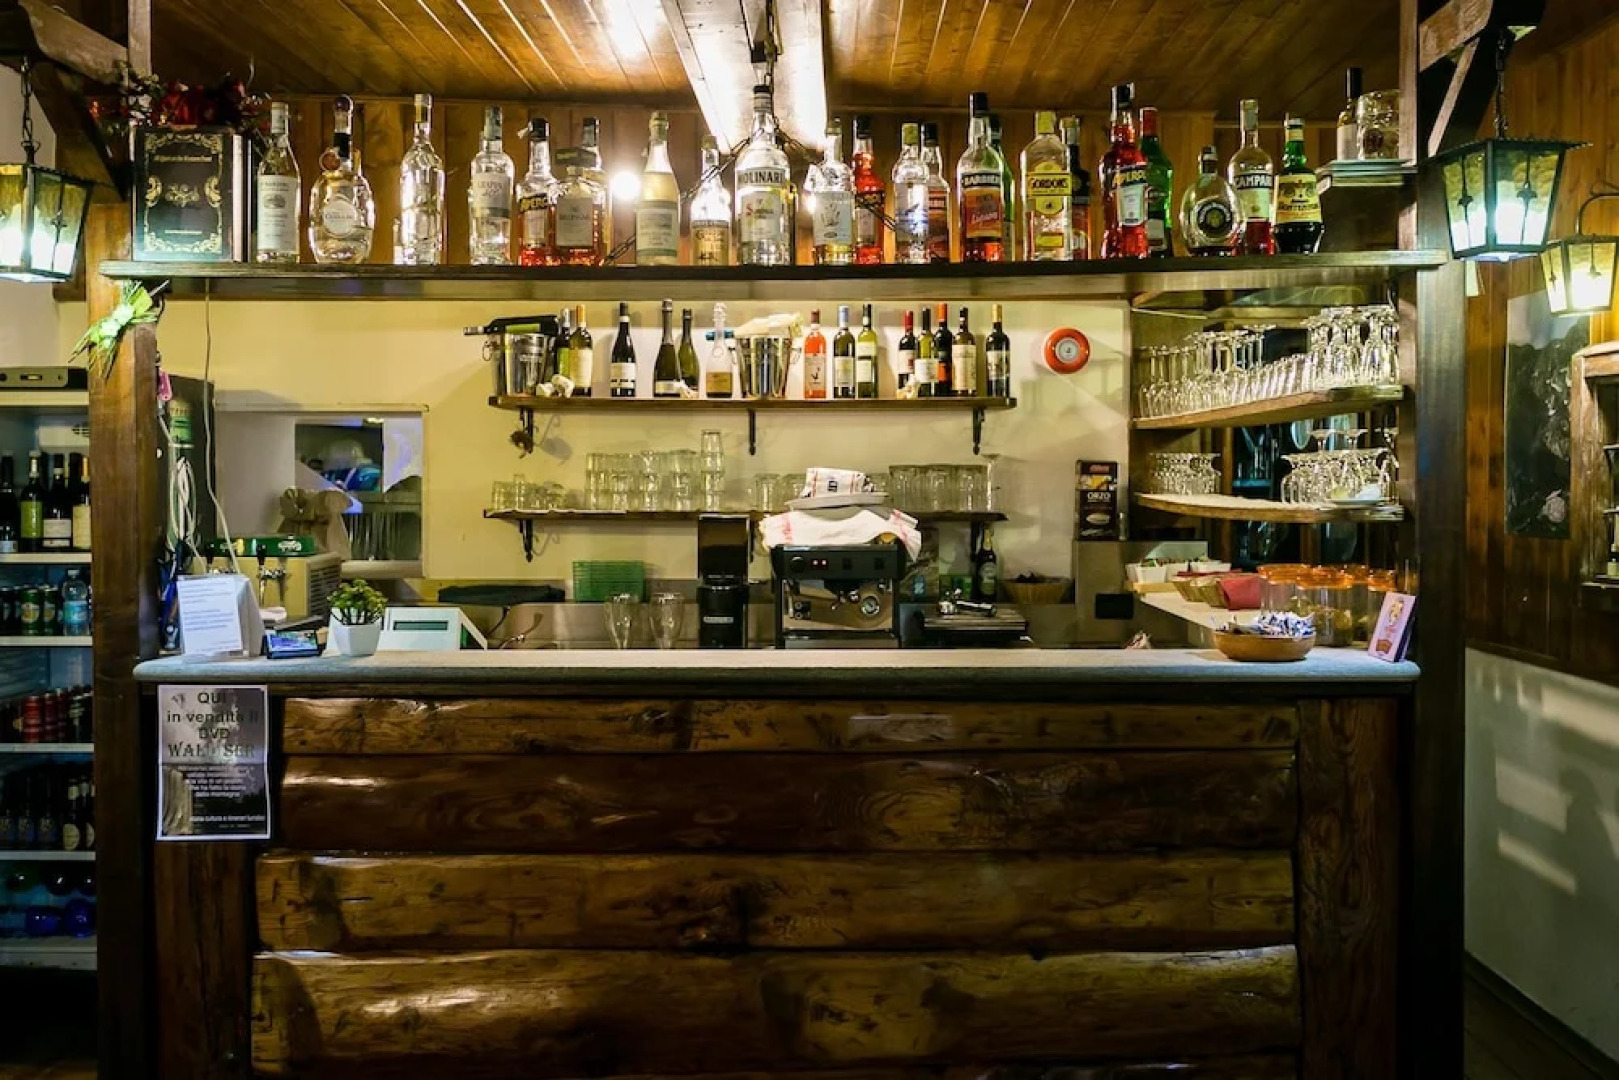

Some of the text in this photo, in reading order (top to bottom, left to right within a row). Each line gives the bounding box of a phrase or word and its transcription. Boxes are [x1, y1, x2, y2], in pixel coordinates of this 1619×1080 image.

[197, 692, 227, 704] QUI
[167, 710, 181, 722] in
[186, 710, 243, 722] vendita
[199, 727, 231, 740] DVD
